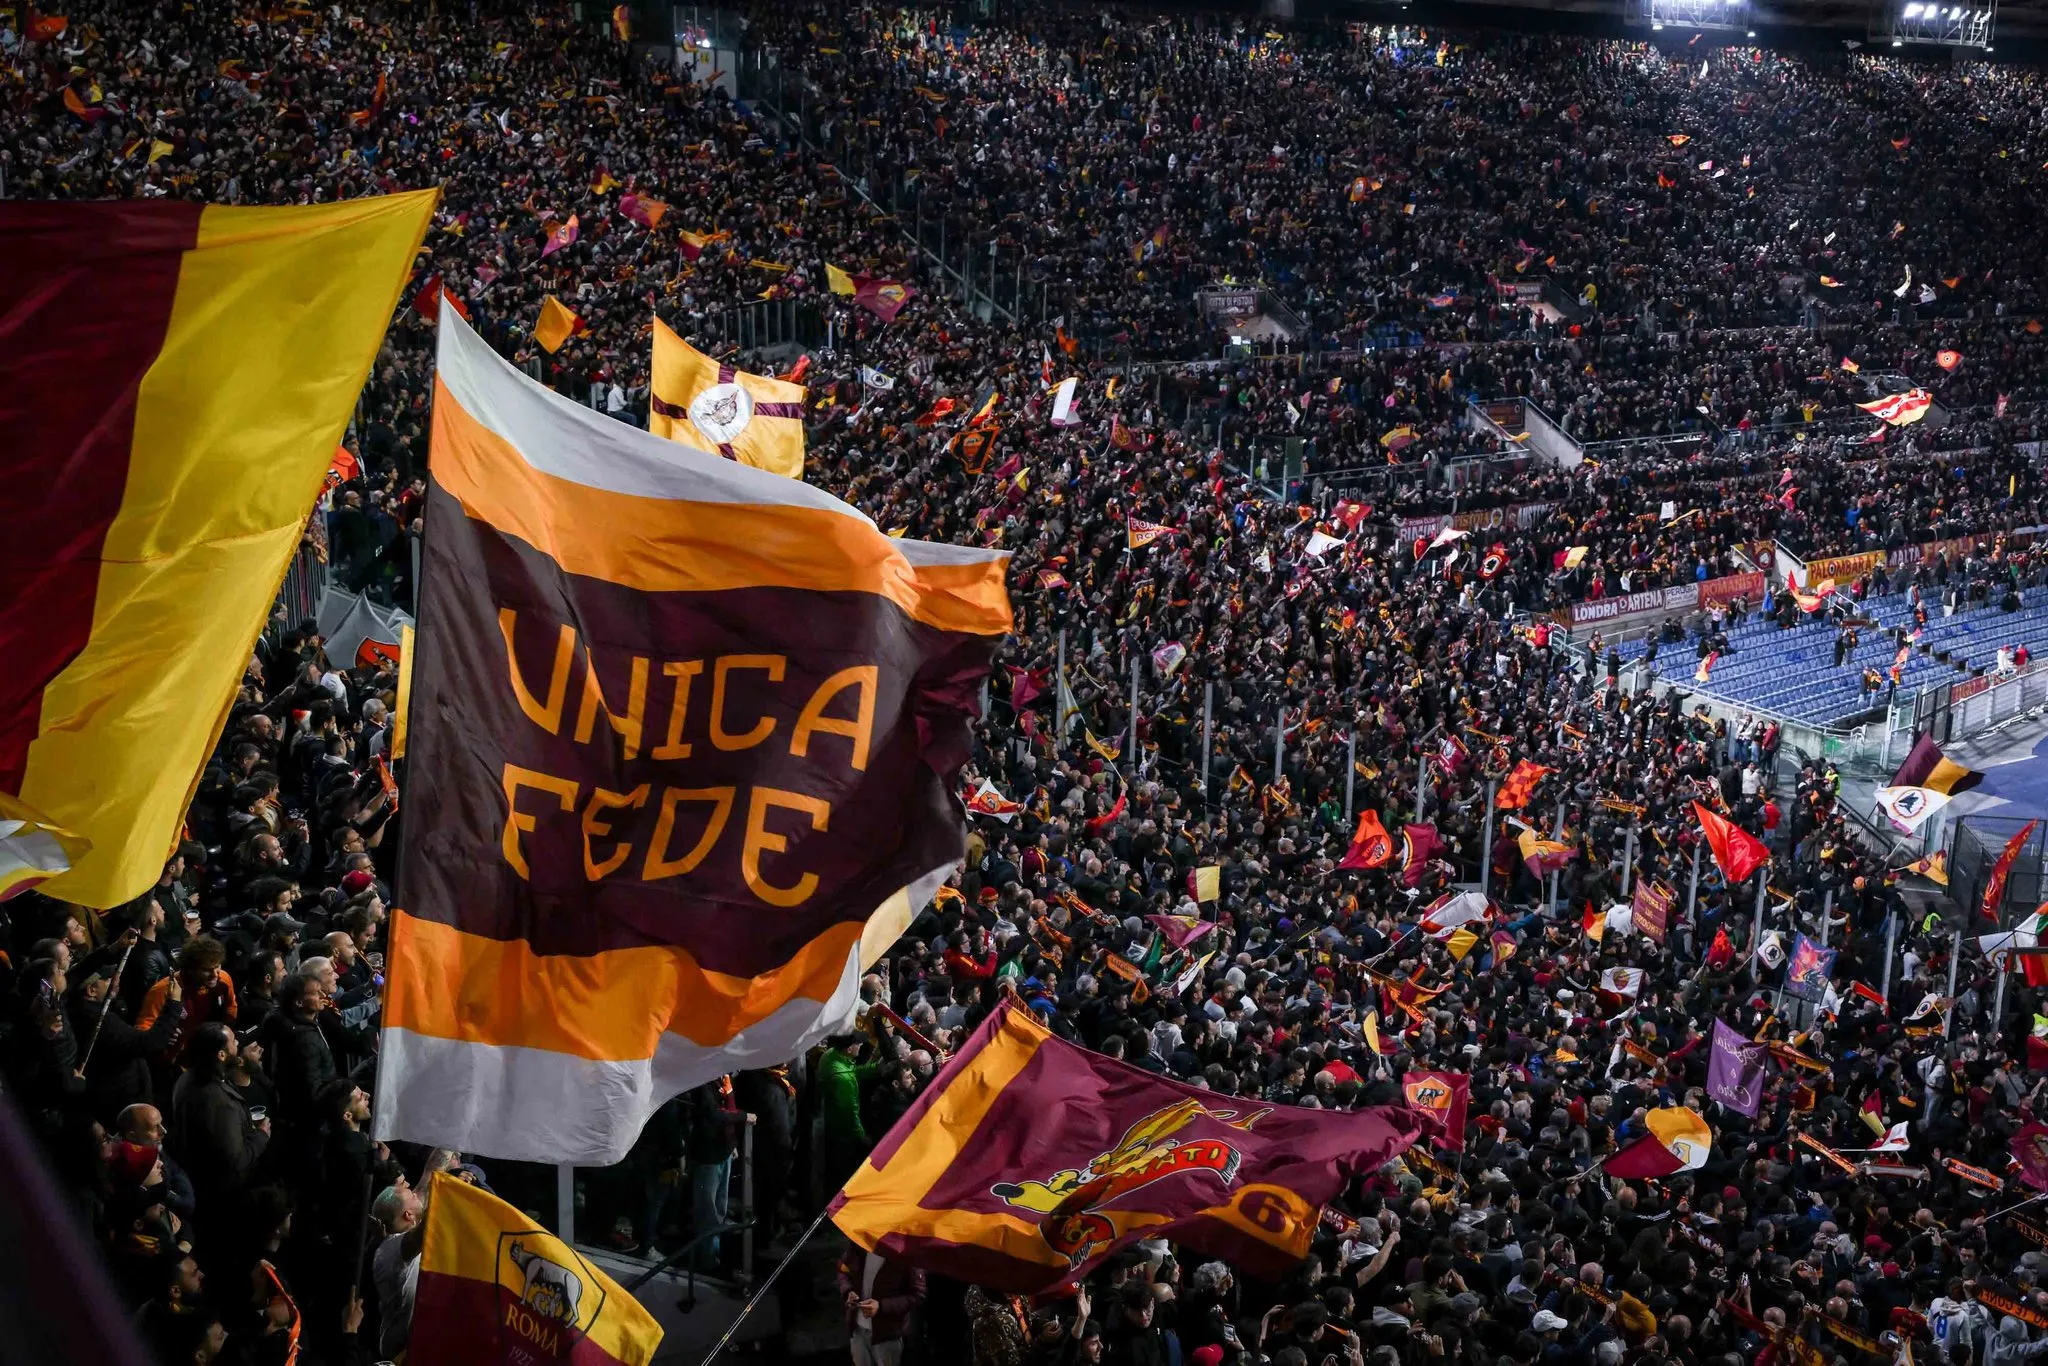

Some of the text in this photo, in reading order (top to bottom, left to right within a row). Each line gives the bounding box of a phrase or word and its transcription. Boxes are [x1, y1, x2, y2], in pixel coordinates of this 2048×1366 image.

[1809, 560, 1872, 580] PALOMBARA
[1574, 601, 1618, 622] LONDRA
[1627, 590, 1664, 613] ARTENA
[499, 607, 879, 772] UNICA
[502, 762, 831, 908] FEDE
[505, 1302, 559, 1358] ROMA
